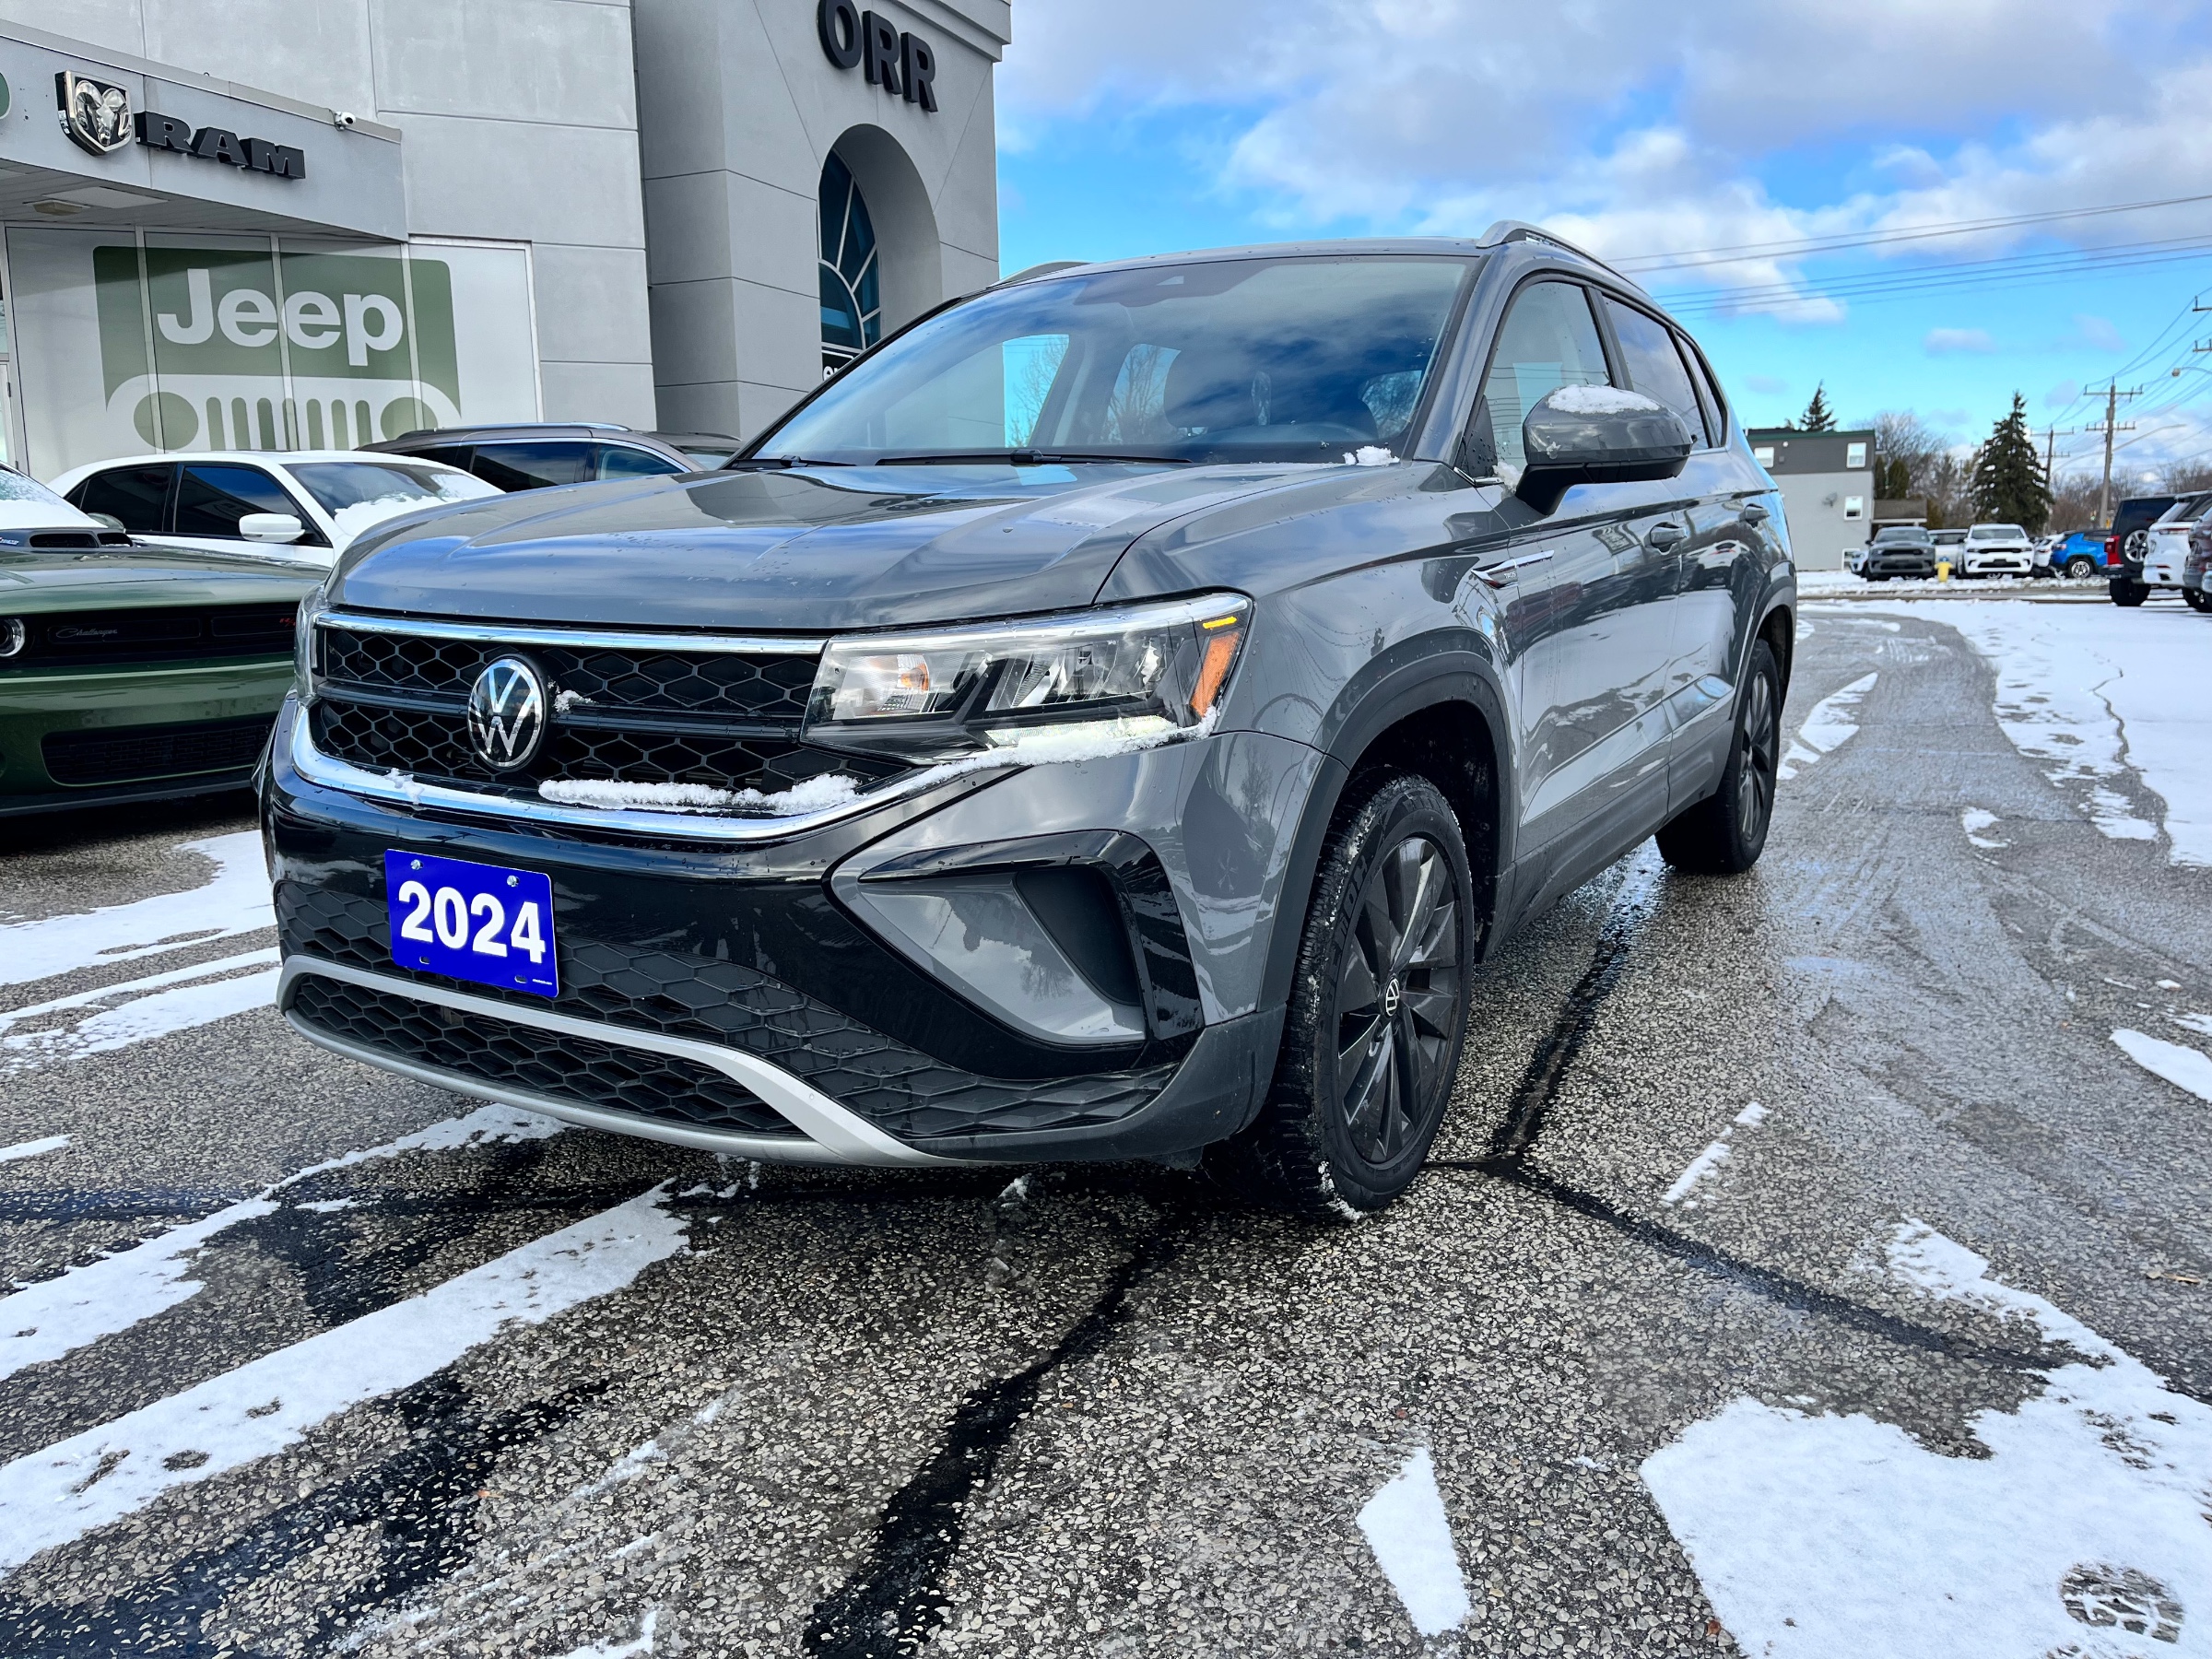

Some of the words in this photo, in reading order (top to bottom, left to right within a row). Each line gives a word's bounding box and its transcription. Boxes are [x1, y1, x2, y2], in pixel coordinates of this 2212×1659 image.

[817, 0, 938, 112] ORR
[135, 111, 306, 180] RAM
[157, 268, 404, 366] Jeep
[55, 628, 118, 639] Challenger
[398, 880, 546, 963] 2024
